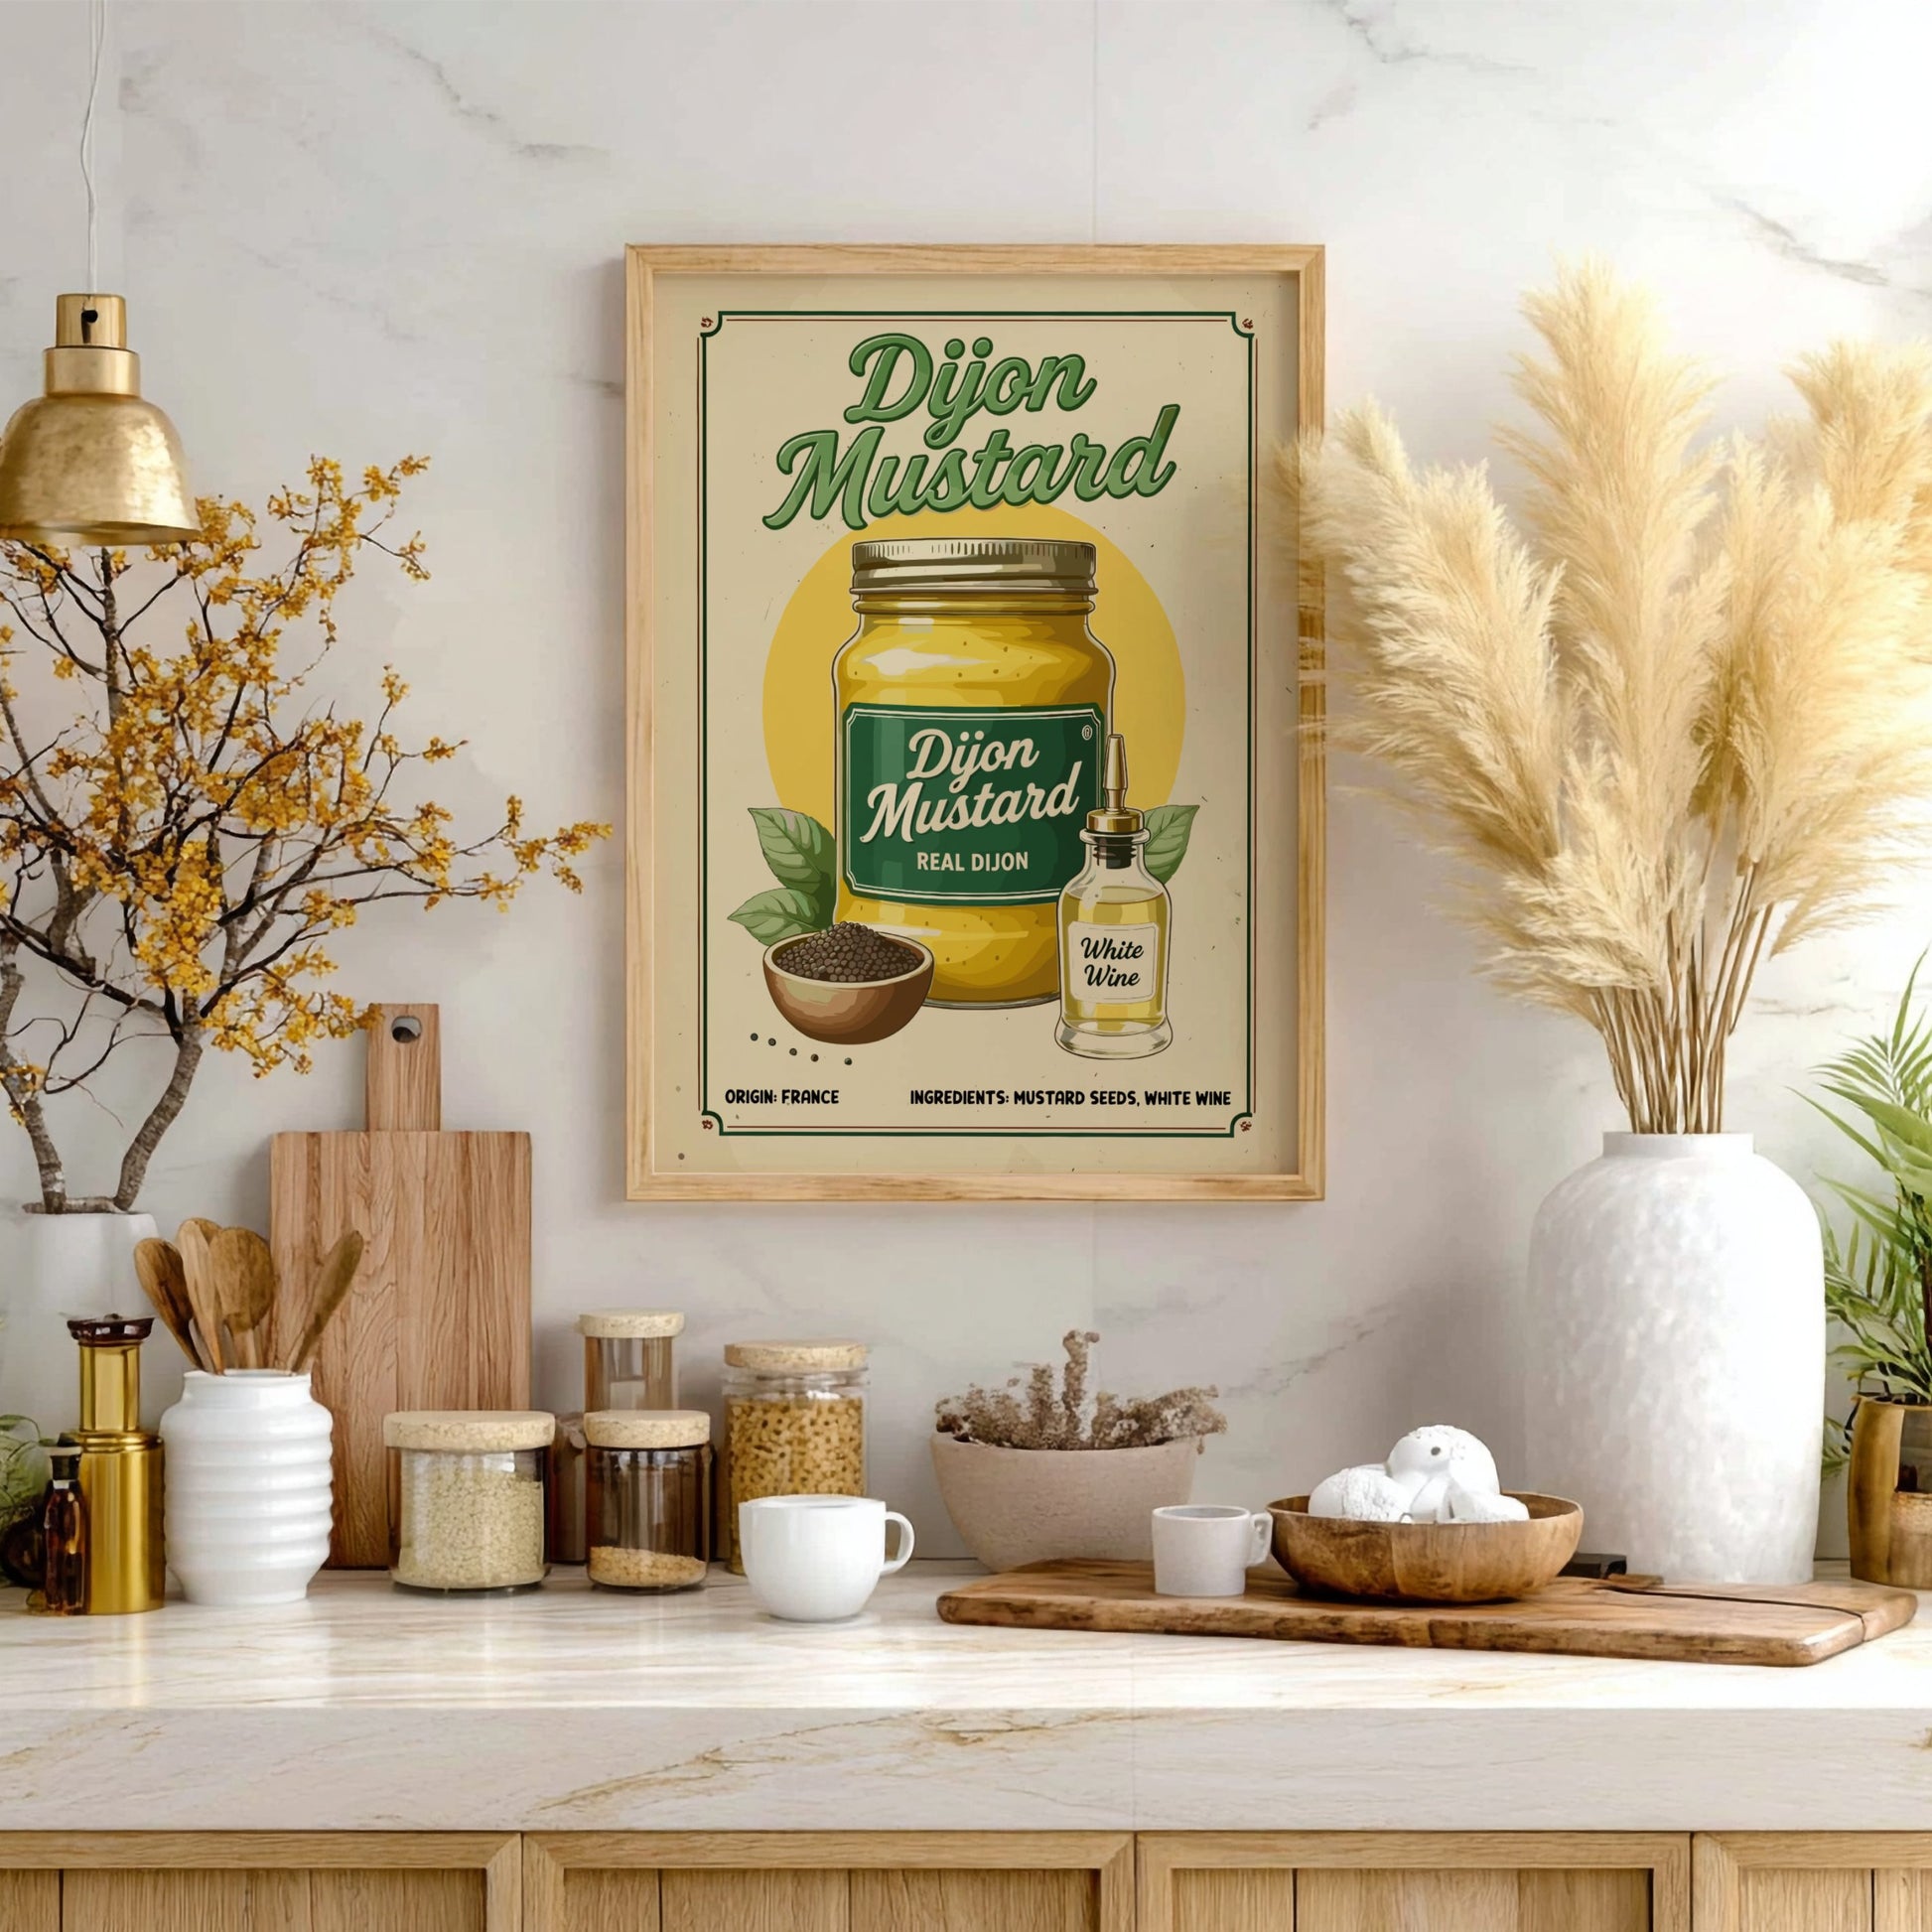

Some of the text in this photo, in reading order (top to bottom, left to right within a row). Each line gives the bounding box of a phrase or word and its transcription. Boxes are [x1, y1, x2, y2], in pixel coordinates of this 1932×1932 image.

[843, 333, 1098, 450] Dijon
[761, 404, 1181, 530] Mustard
[905, 728, 1040, 793] Dijon
[859, 760, 1083, 843] Mustard
[916, 851, 1029, 872] REAL DIJON
[1080, 936, 1144, 960] White
[1084, 963, 1141, 987] Wine
[725, 1089, 840, 1104] ORIGIN: FRANCE
[909, 1089, 1232, 1107] INGREDIENTS: MUSTARD SEEDS, WHITE WINE
